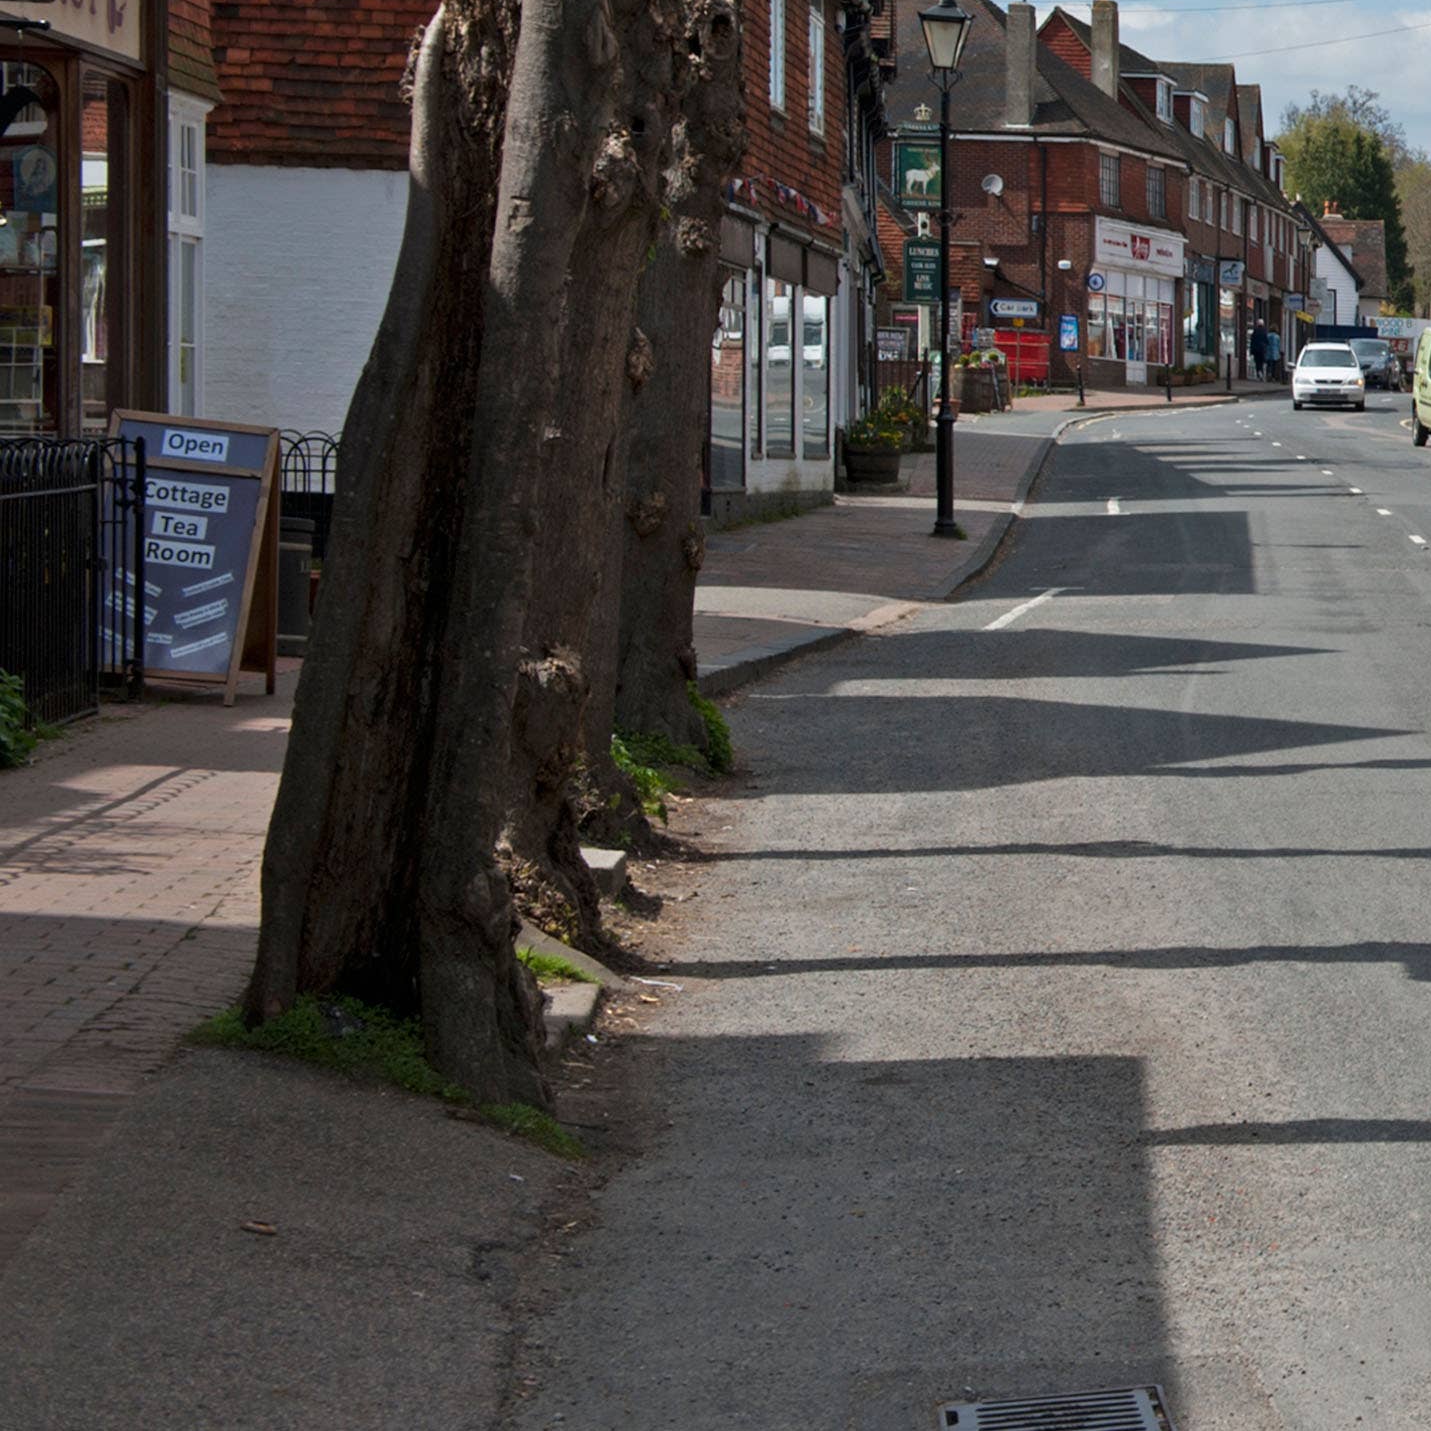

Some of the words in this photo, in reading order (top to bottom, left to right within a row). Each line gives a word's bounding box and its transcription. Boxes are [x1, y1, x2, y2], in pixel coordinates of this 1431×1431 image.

[1000, 303, 1014, 311] Car
[168, 433, 224, 455] Open
[144, 480, 227, 509] Cottage
[160, 515, 198, 536] Tea
[146, 542, 211, 565] Room
